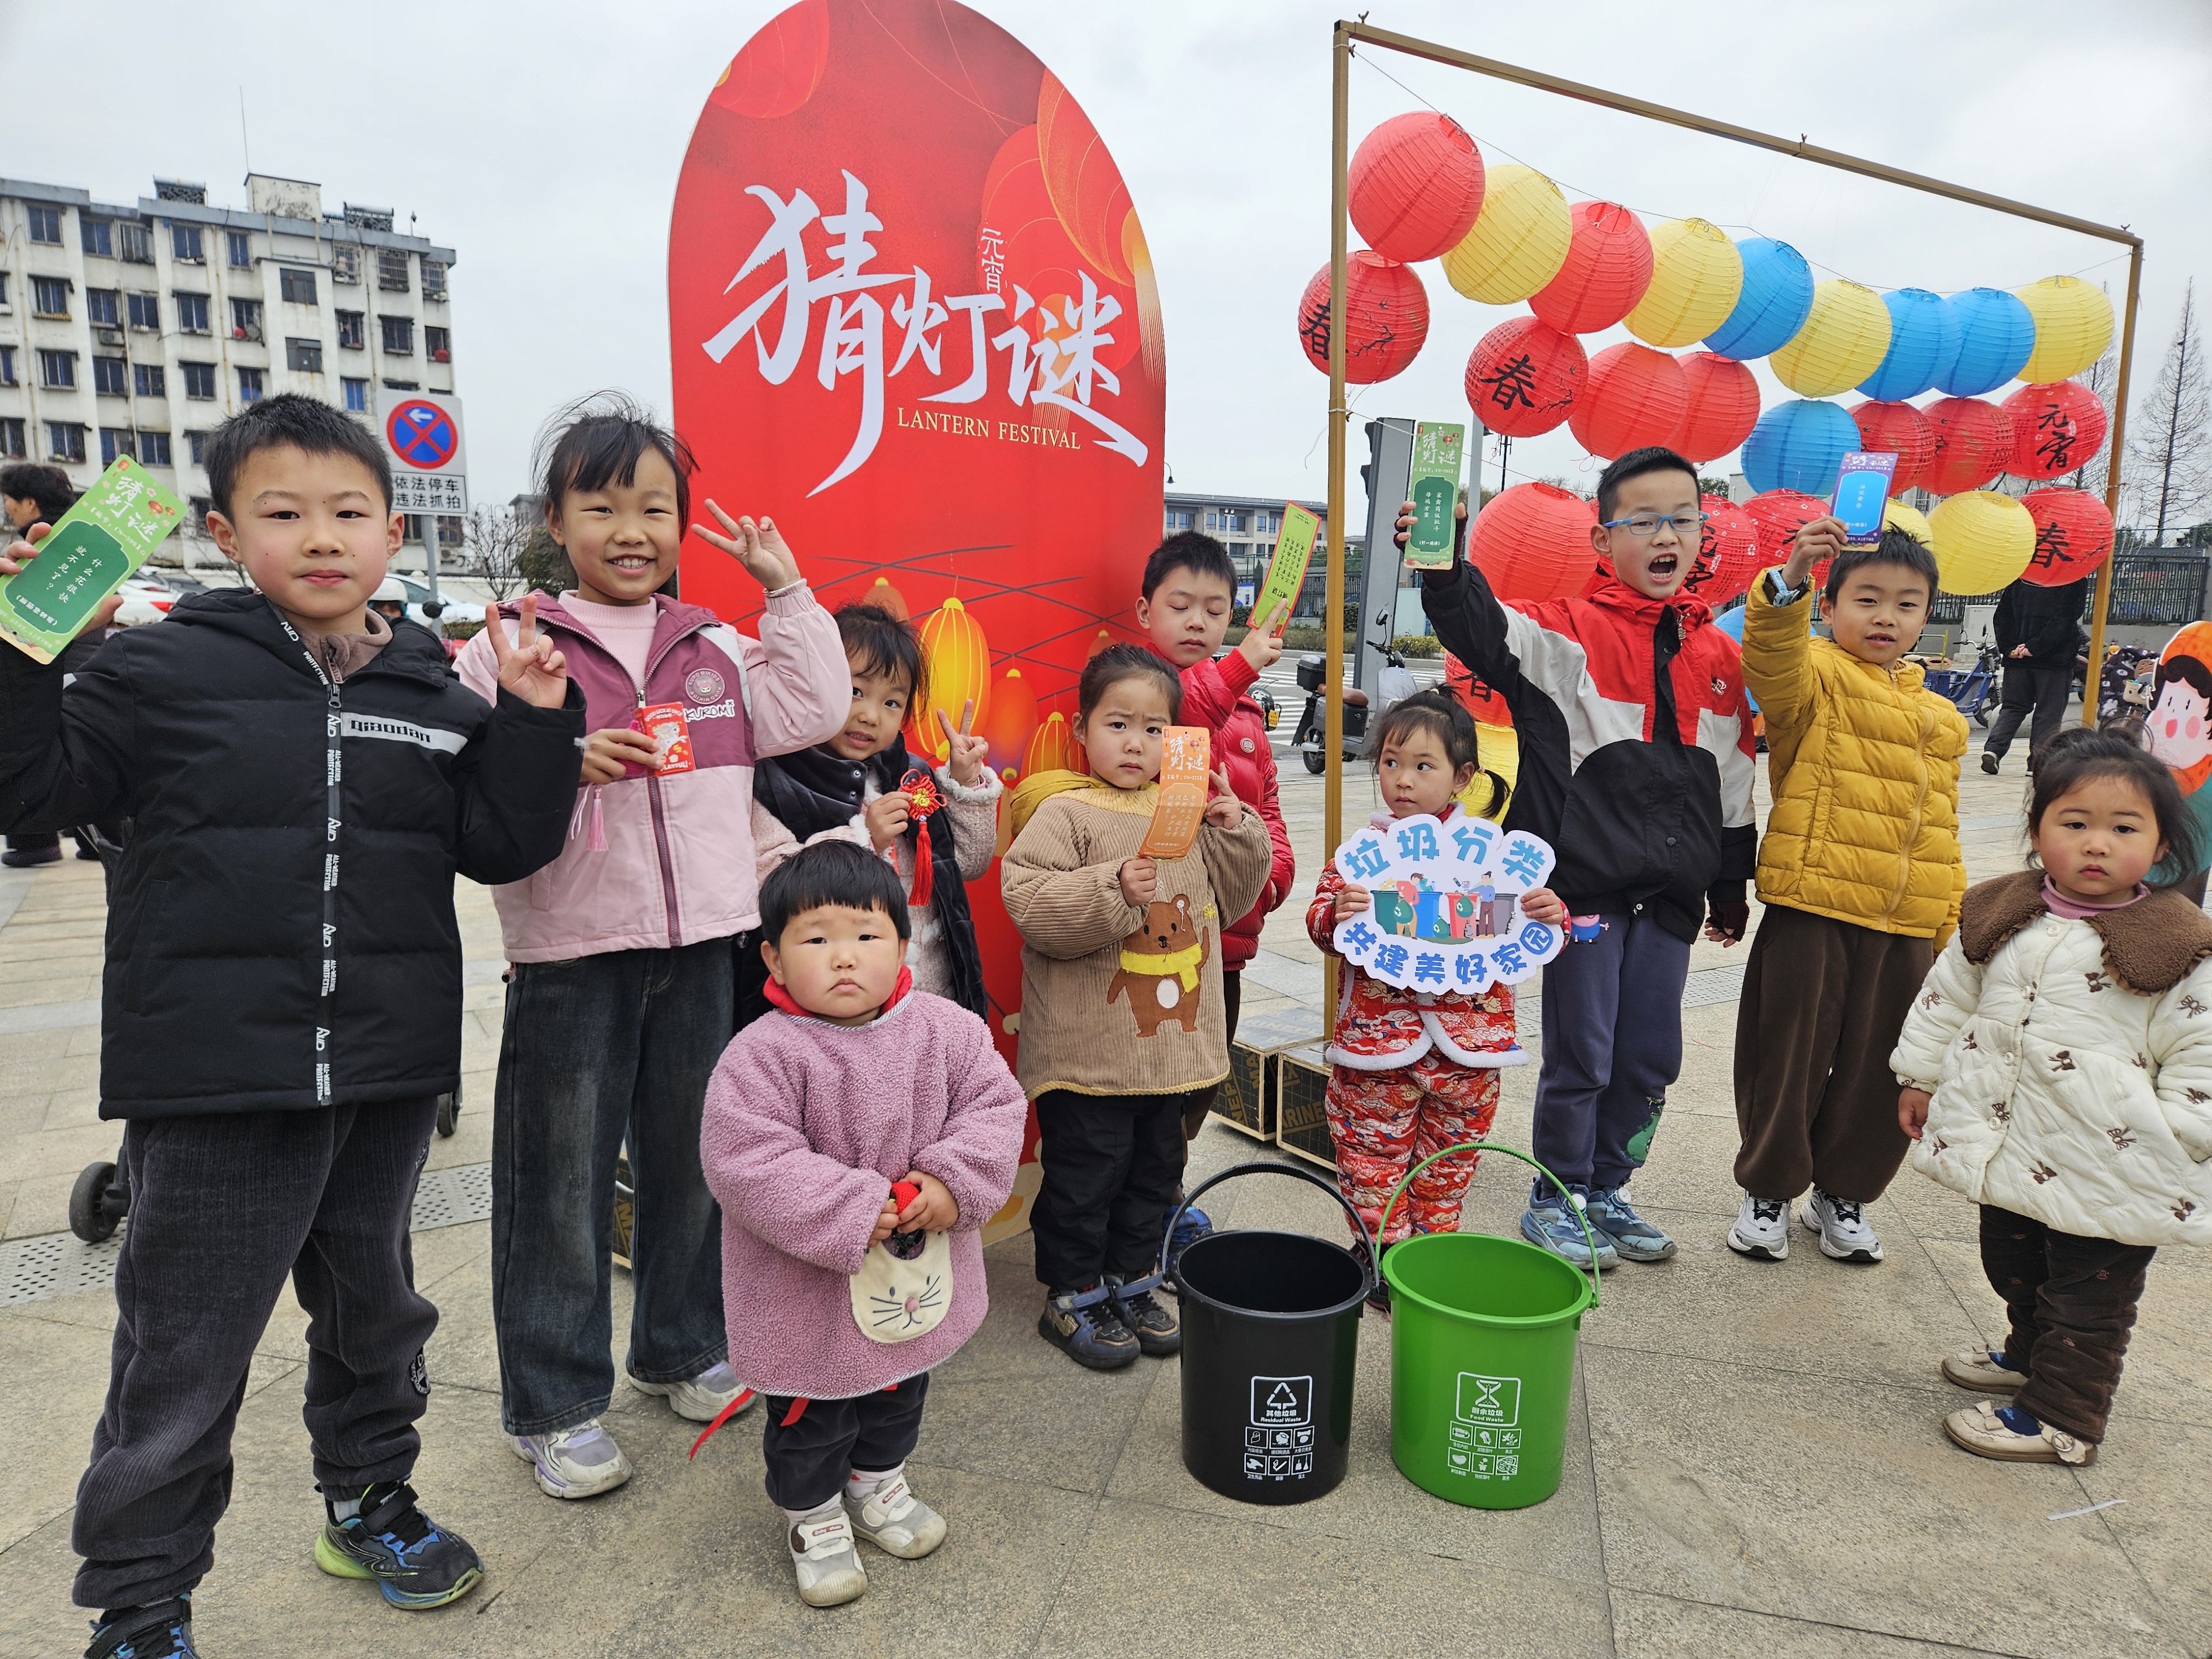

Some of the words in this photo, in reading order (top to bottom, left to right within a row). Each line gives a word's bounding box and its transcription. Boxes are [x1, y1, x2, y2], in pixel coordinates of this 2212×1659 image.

[978, 227, 1005, 294] 元宵
[702, 169, 1148, 498] 猜灯谜
[1480, 354, 1536, 410] 春
[898, 407, 989, 437] LANTERN
[998, 421, 1082, 450] FESTIVAL
[2037, 404, 2077, 469] 元宵
[395, 475, 460, 493] 依法停车
[396, 492, 461, 509] 违法抓拍
[105, 476, 158, 542] 猜灯谜
[2031, 522, 2074, 568] 春
[59, 559, 103, 603] 什么花很快
[303, 650, 329, 685] PROTECTION
[1170, 735, 1204, 771] 猜灯谜
[324, 853, 332, 891] PROTECTION
[1344, 823, 1546, 887] 垃圾分类
[1343, 922, 1553, 984] 共建美好家园
[321, 959, 330, 997] PROTECTION
[1472, 1407, 1503, 1416] 厨余垃圾
